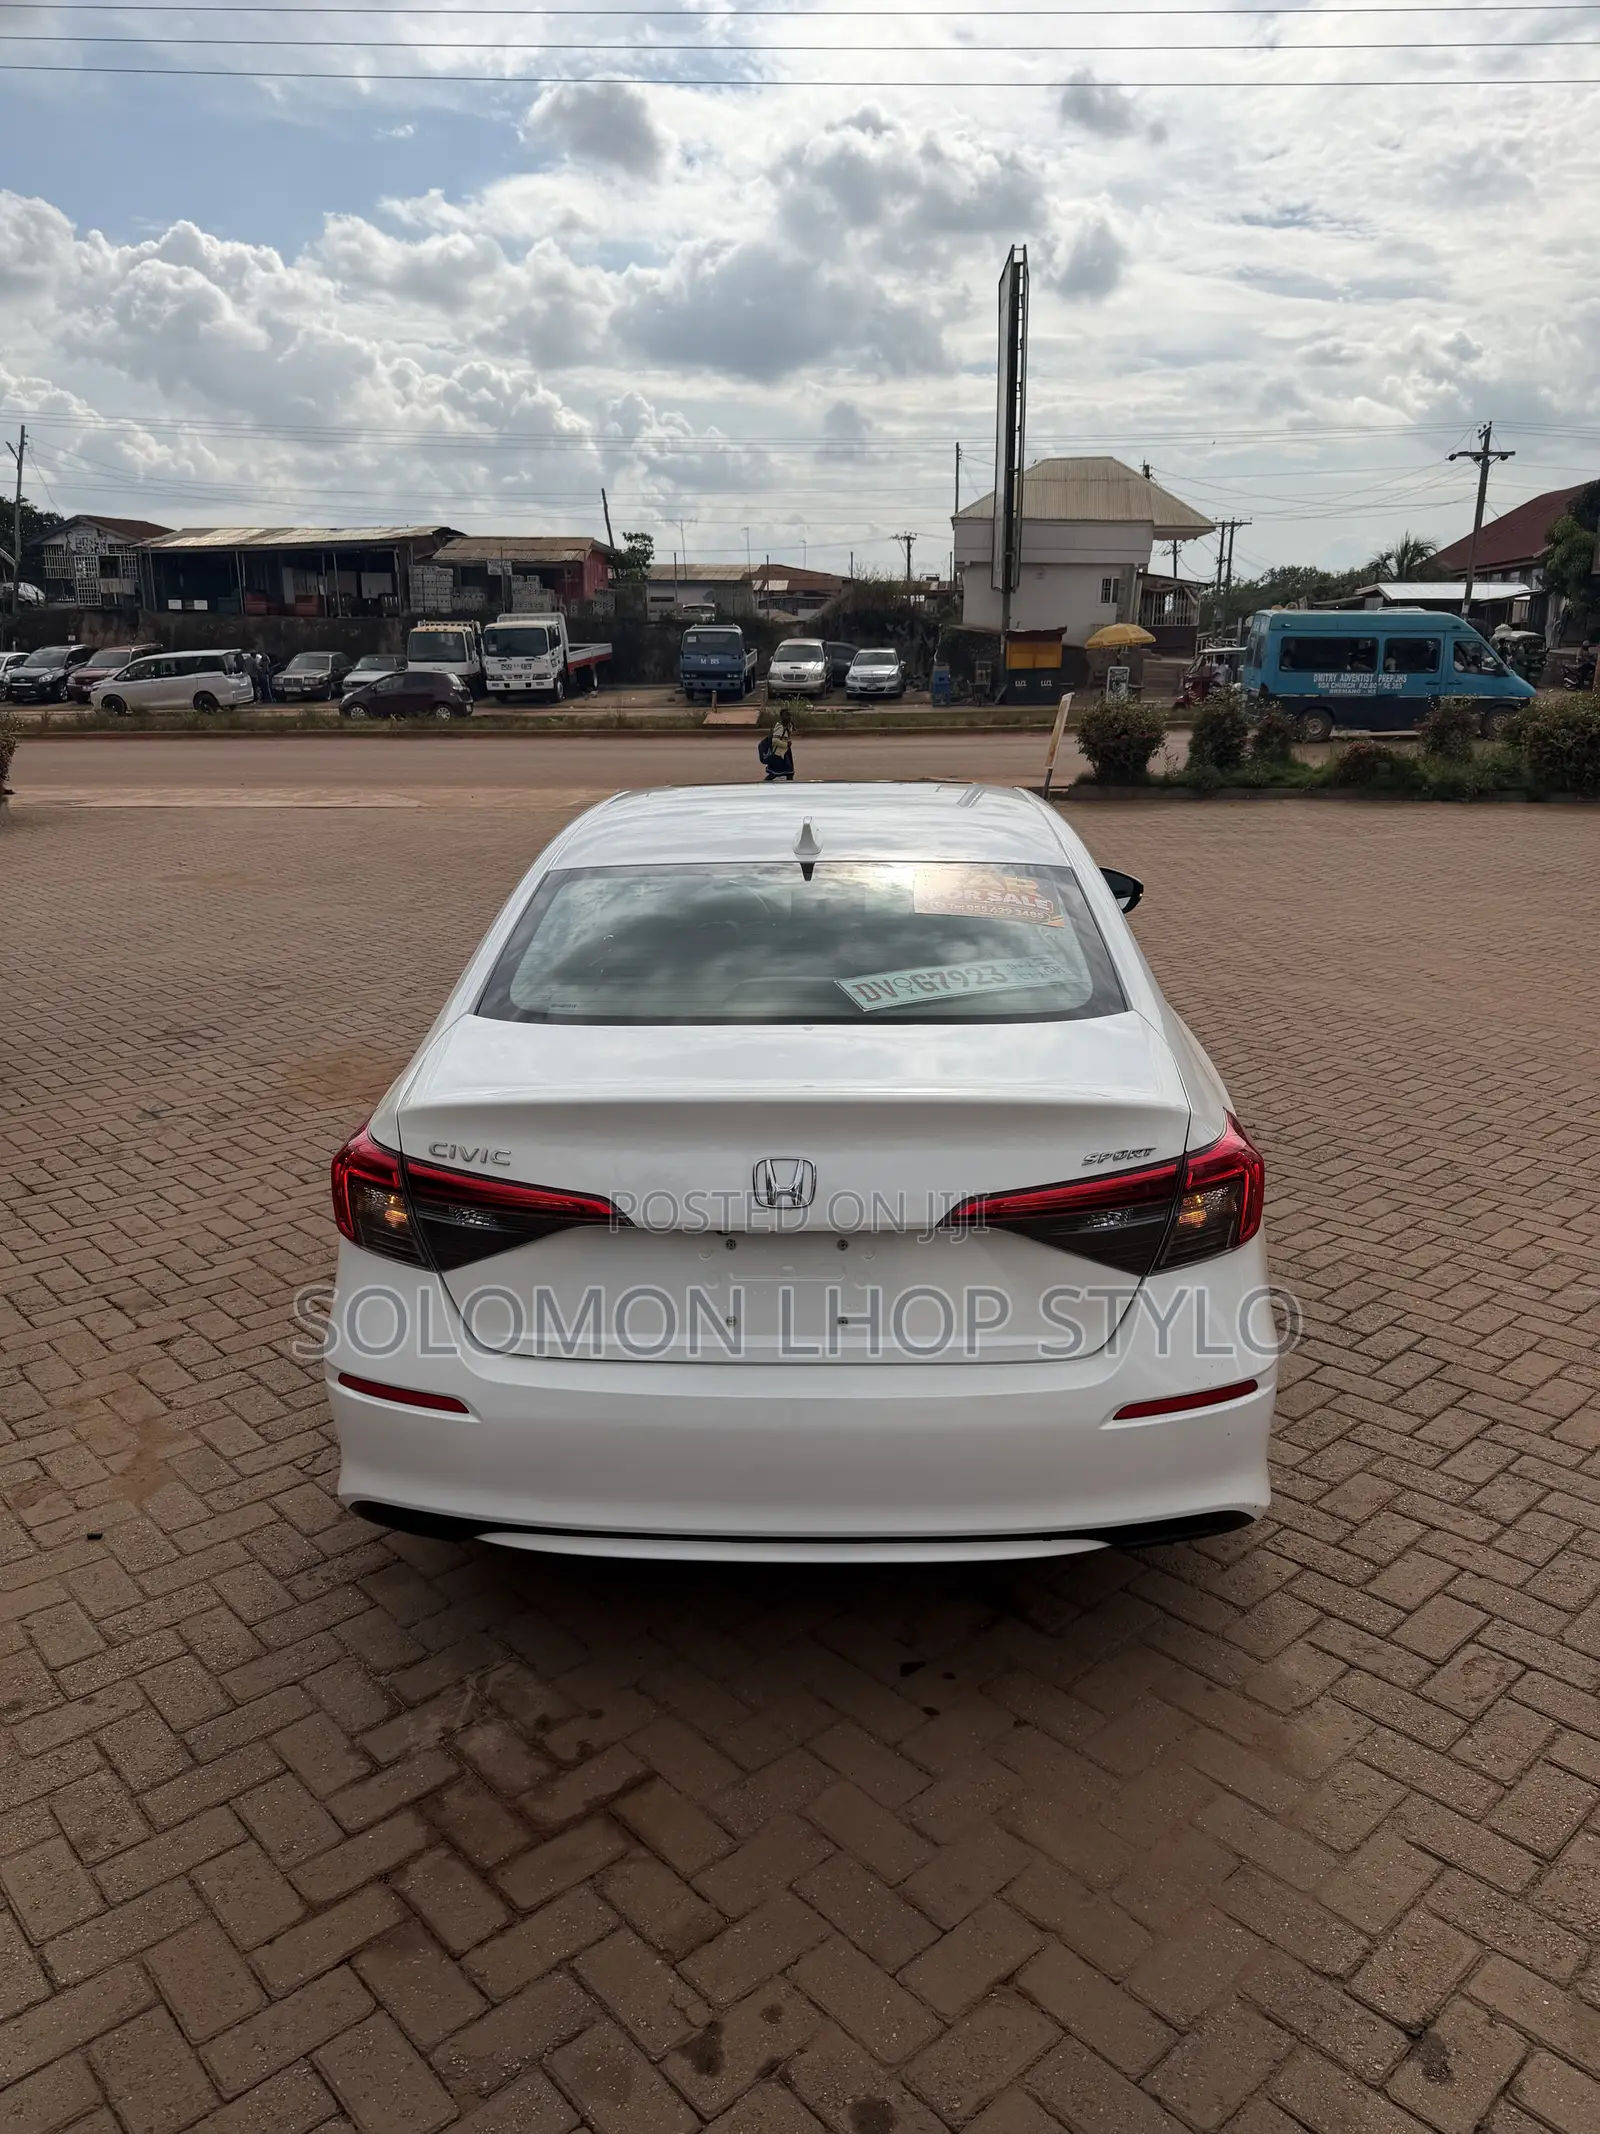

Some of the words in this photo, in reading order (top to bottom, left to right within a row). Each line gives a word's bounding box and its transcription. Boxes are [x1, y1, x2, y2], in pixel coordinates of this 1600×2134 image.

[1339, 673, 1374, 682] ADVENTIST
[986, 890, 1051, 911] SALE
[1014, 909, 1045, 919] 3485
[428, 1141, 512, 1166] CIVIC
[1081, 1147, 1157, 1167] SPORT
